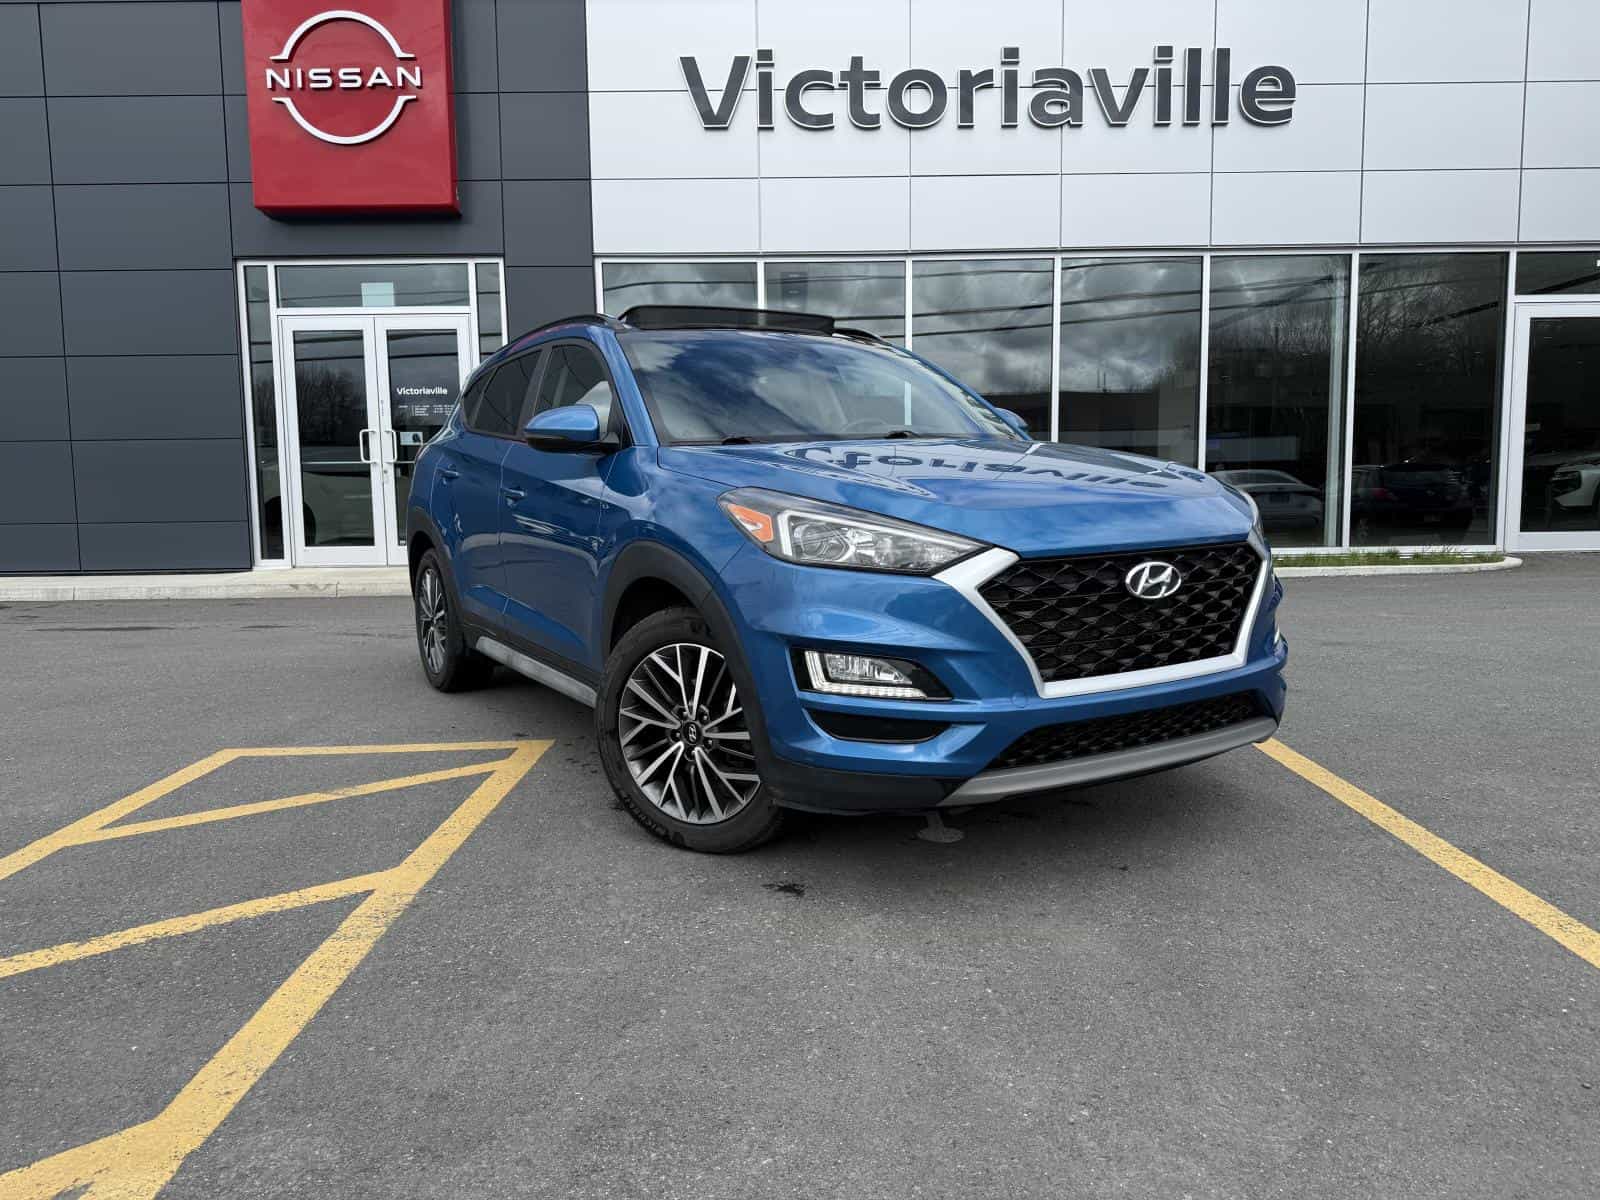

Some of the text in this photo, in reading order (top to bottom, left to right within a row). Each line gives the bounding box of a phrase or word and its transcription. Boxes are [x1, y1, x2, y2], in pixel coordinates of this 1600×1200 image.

[265, 66, 422, 89] NISSAN
[679, 46, 1297, 131] Victoriaville
[396, 386, 448, 396] Victoriaville
